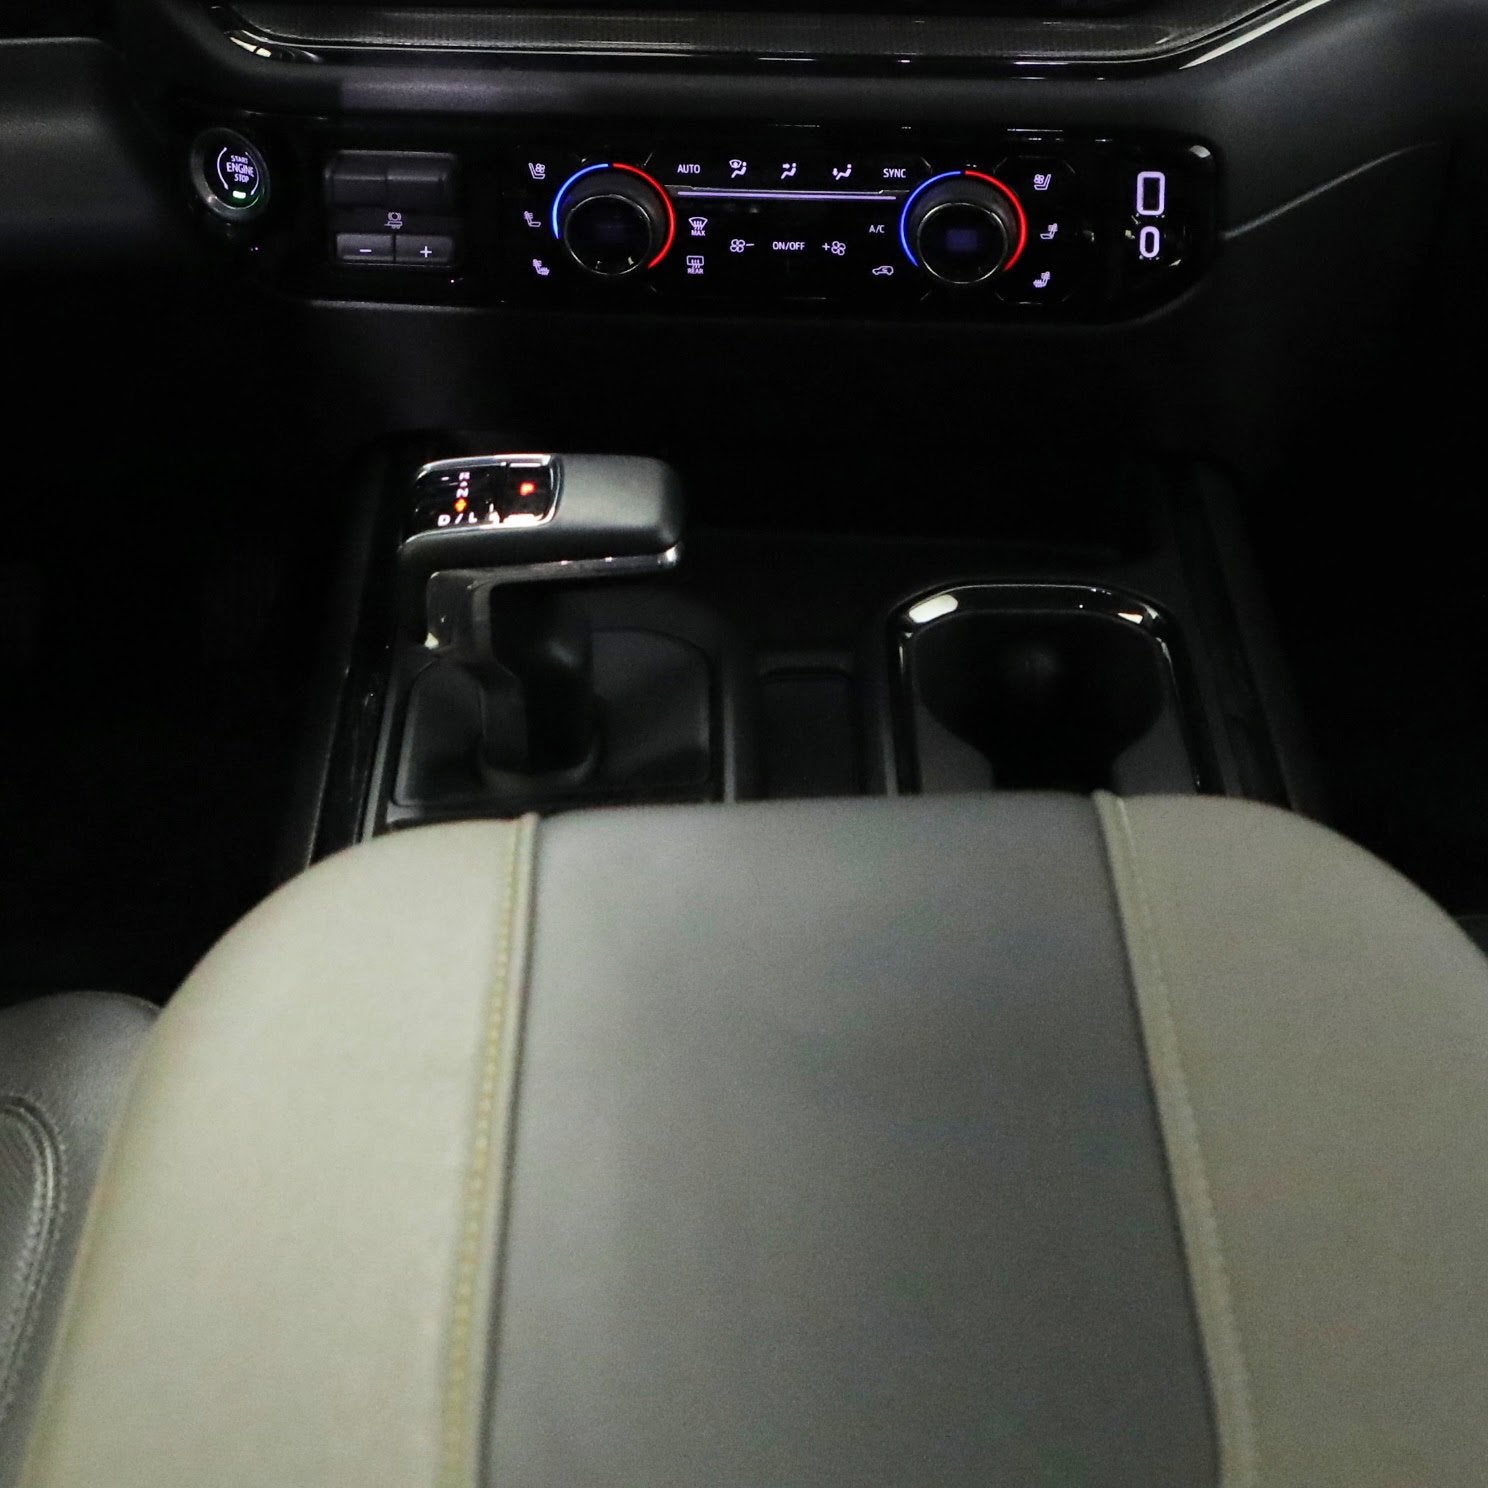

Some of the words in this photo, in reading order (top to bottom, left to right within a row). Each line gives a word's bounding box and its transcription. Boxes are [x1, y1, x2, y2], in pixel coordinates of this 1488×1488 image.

[226, 161, 254, 177] ENGINE
[677, 164, 701, 174] AUTO
[883, 168, 906, 179] SYNC
[234, 173, 250, 183] STOP
[868, 224, 885, 234] A/C
[772, 241, 805, 251] ON/OFF
[687, 266, 704, 275] REAR
